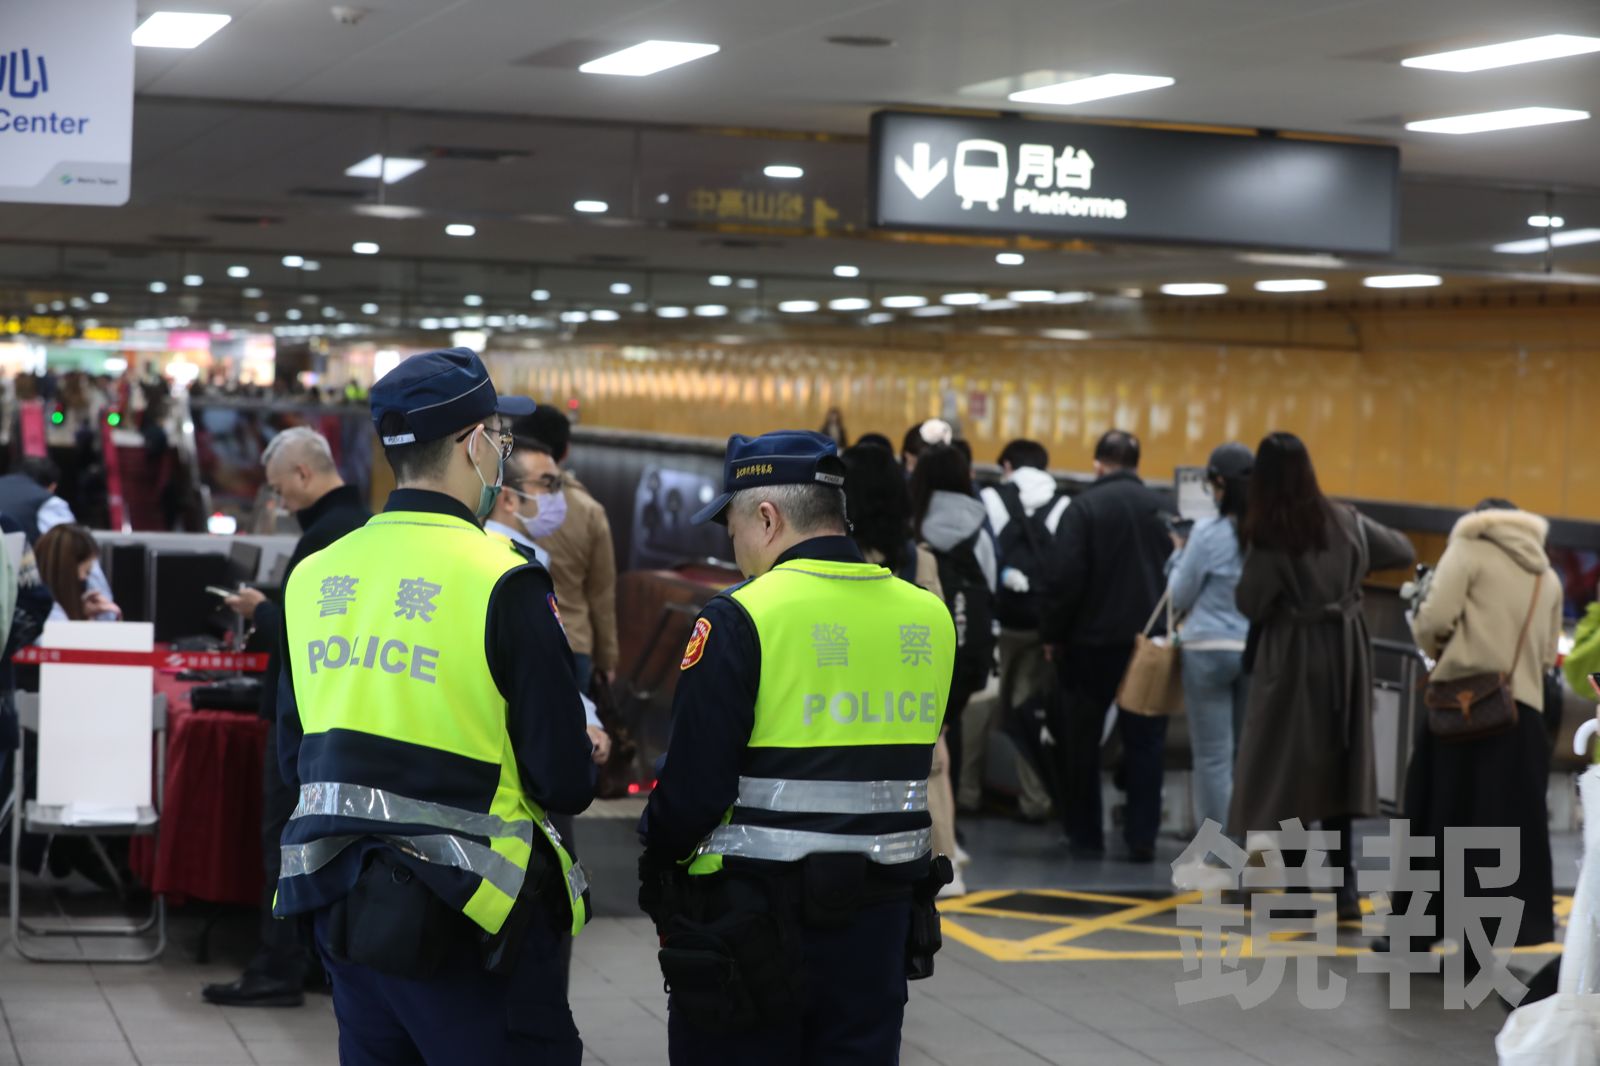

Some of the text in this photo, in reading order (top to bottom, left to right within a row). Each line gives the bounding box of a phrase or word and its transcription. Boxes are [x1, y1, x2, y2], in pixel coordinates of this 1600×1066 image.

[1015, 143, 1095, 190] 月台
[1013, 188, 1127, 219] Platforms
[308, 635, 440, 684] POLICE
[803, 690, 937, 726] POLICE
